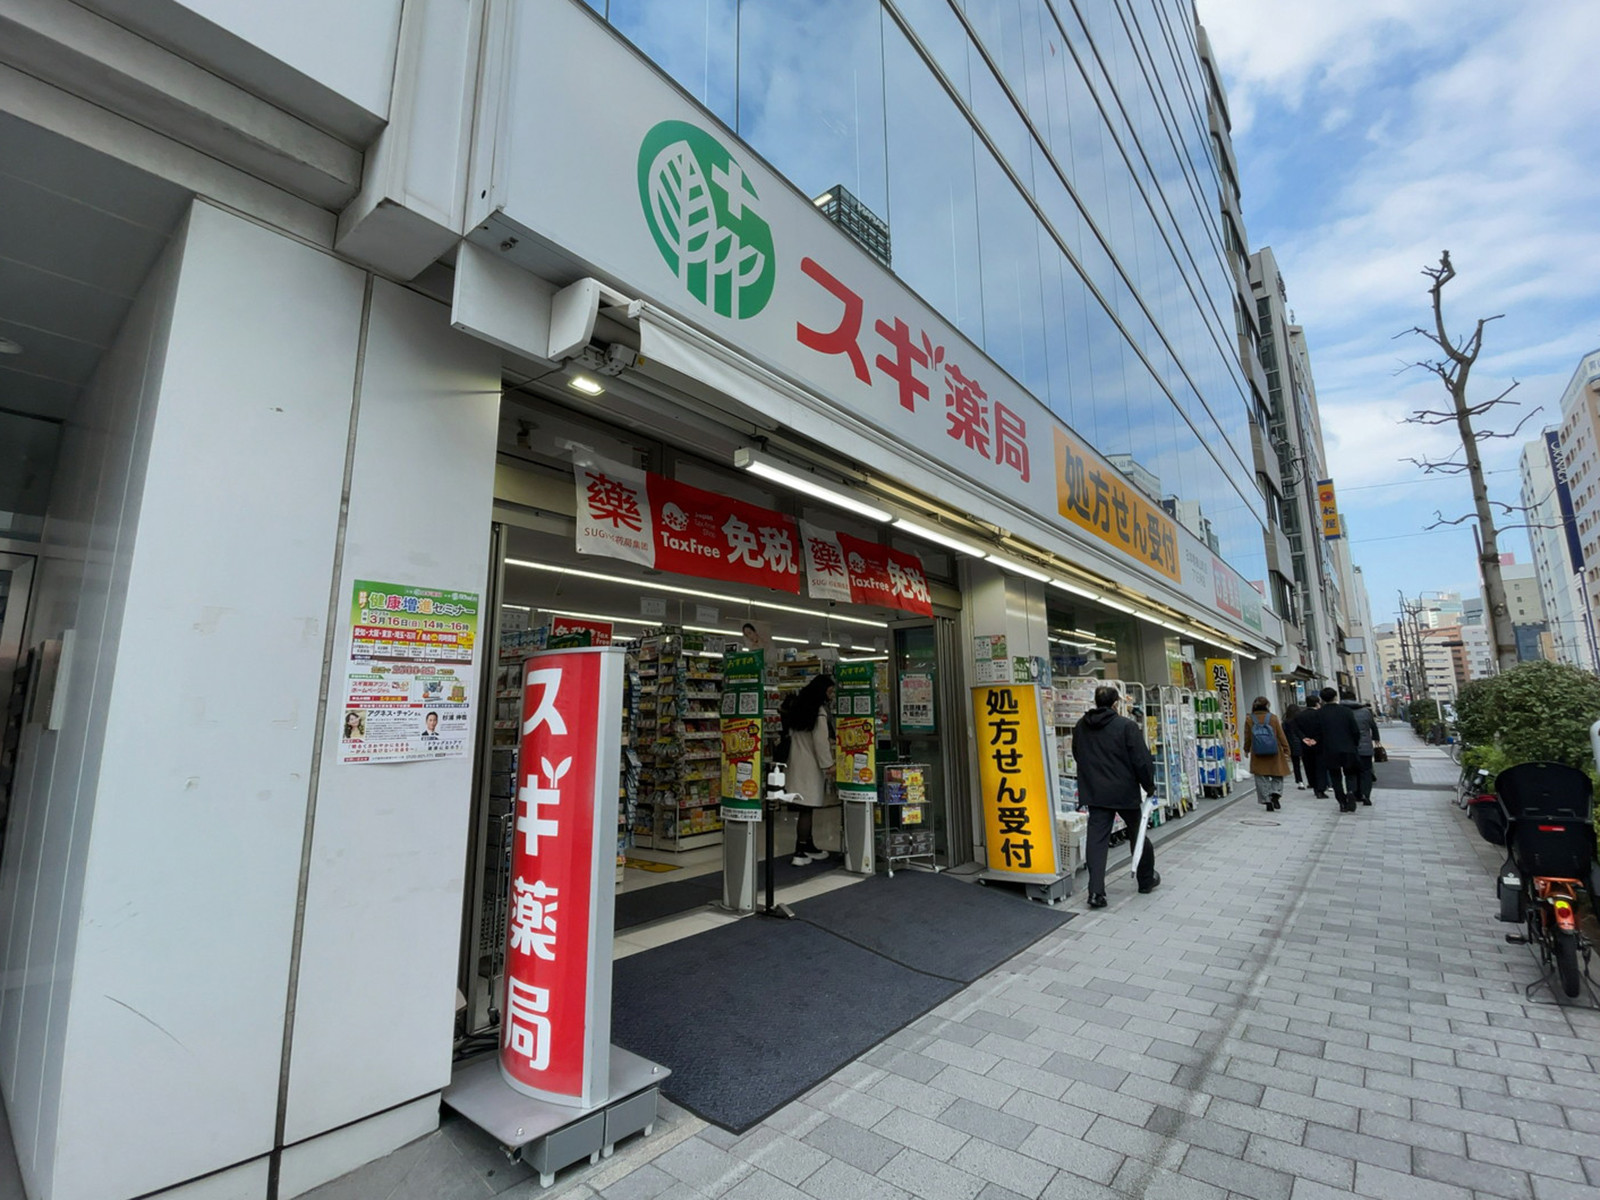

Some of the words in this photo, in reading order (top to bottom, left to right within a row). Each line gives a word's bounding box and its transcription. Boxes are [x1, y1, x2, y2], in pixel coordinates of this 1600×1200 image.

[796, 256, 1030, 483] スギ薬局
[721, 513, 797, 575] 免税
[1065, 446, 1176, 574] 処方せん受付
[368, 592, 476, 616] 健康増進セミナー
[886, 557, 931, 604] 免税
[986, 689, 1035, 869] 処方せん受付
[505, 667, 573, 1072] スギ薬局
